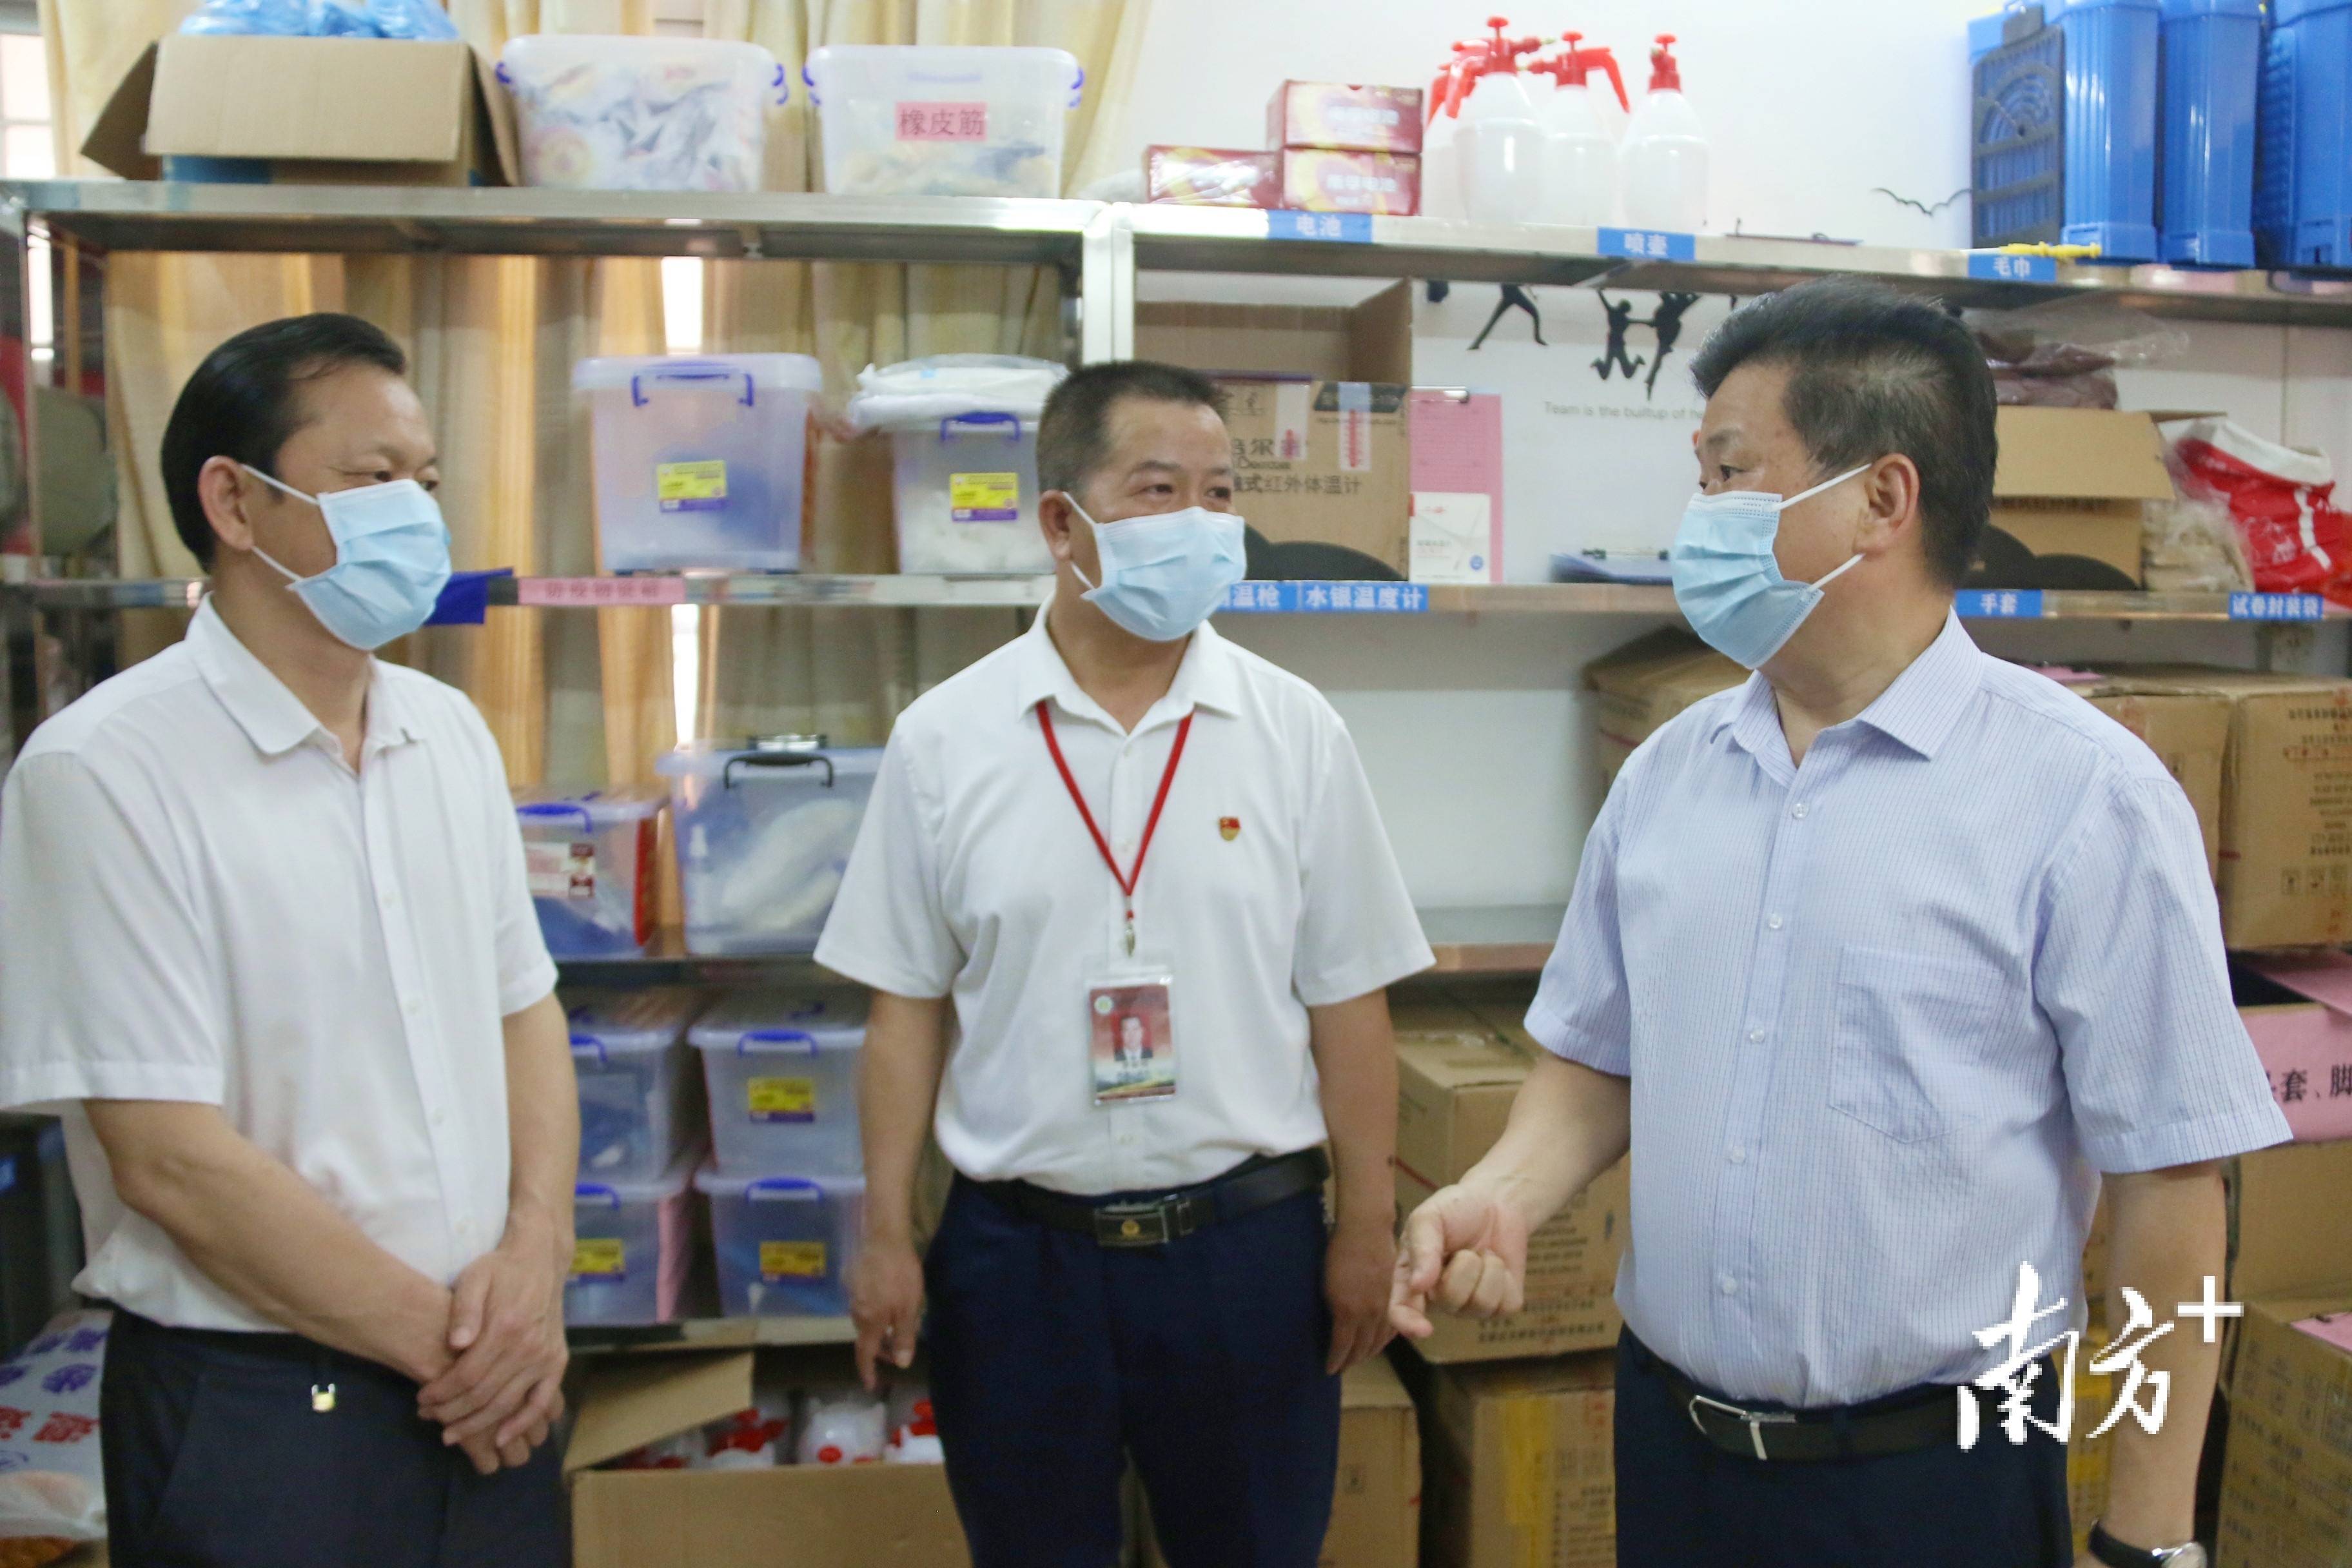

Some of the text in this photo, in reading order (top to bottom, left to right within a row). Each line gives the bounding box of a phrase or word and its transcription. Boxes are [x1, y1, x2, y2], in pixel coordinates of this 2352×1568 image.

[899, 108, 986, 137] 橡皮筋
[1296, 213, 1342, 238] 电池
[1623, 232, 1668, 256] 喷壶
[1993, 257, 2030, 279] 毛巾
[1544, 401, 1580, 415] Team
[1583, 406, 1594, 416] is
[1598, 406, 1620, 417] the
[1671, 407, 1686, 419] of
[1222, 585, 1280, 607] 温枪
[1305, 585, 1424, 609] 水银温度计
[1980, 592, 2017, 616] 手套
[2265, 1063, 2352, 1104] 套、脚
